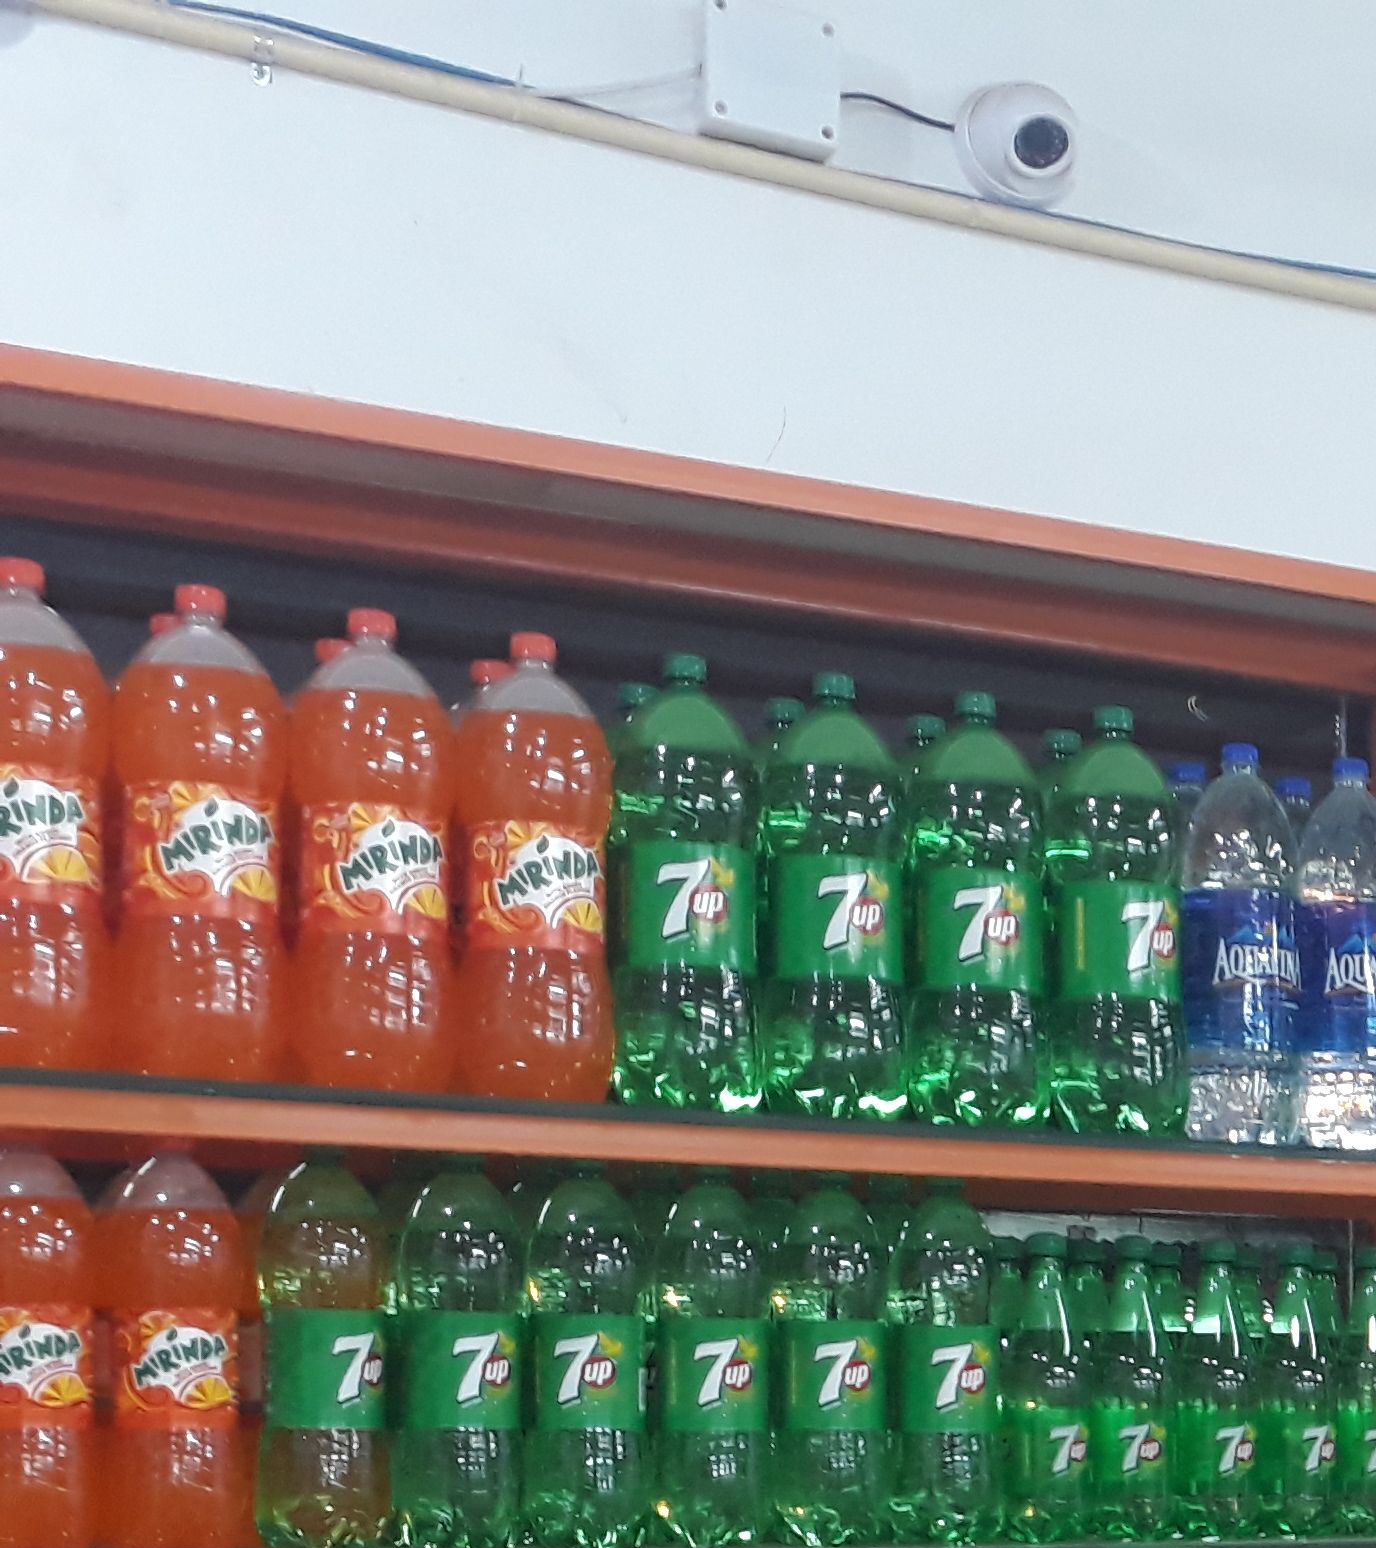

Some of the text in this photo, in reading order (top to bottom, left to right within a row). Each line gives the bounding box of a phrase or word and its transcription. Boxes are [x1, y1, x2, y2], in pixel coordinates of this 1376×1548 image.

[160, 798, 271, 871] MIRINDA
[340, 818, 442, 891] MIRINDA
[498, 835, 597, 905] MIRINDA
[0, 1325, 81, 1376] IRINDA
[135, 1327, 227, 1388] MIRINDA
